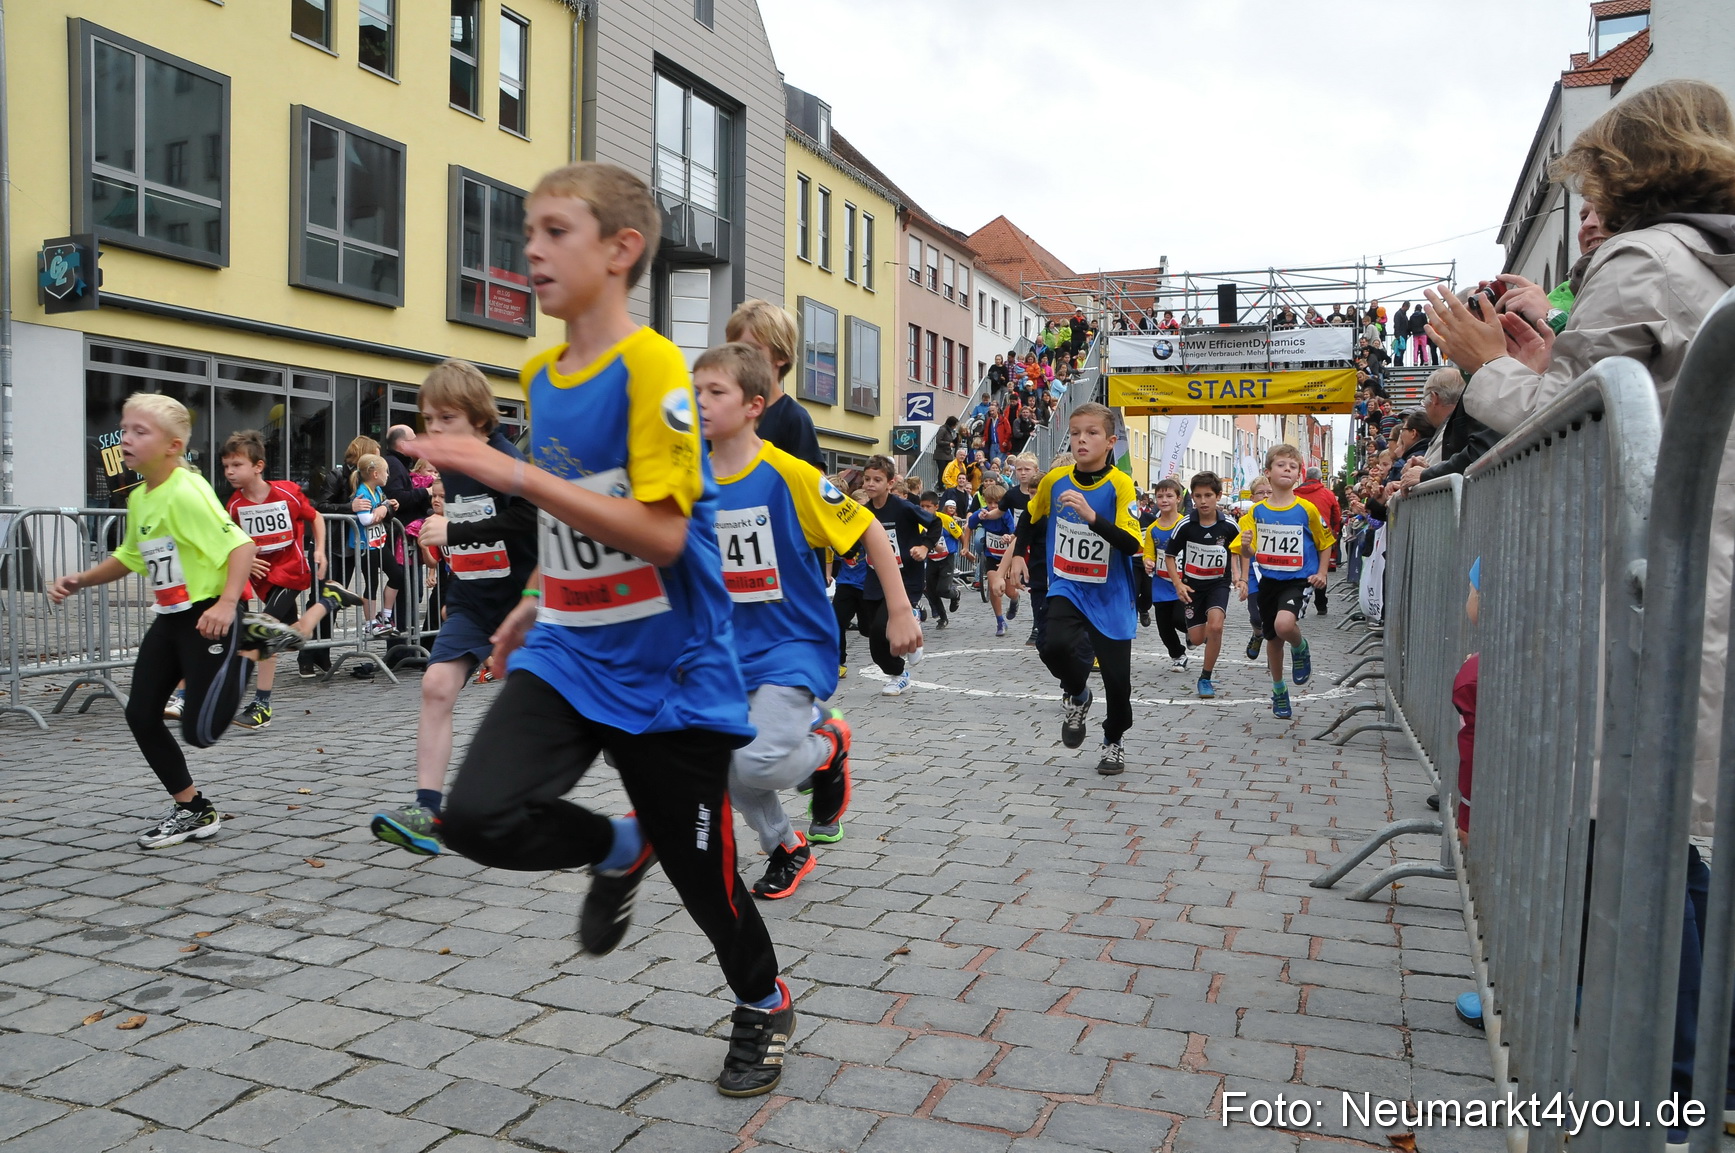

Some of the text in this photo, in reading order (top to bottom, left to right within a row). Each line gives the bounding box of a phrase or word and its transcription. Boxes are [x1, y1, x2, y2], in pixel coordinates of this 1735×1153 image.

[1179, 337, 1306, 353] BMW EfficientDynamics
[1208, 350, 1245, 358] Verbrauch.
[1266, 348, 1306, 356] ahrfreude.
[1187, 378, 1272, 400] START
[1171, 442, 1182, 460] BKK
[244, 512, 287, 534] 7098
[1059, 532, 1105, 562] 7162
[1261, 535, 1299, 553] 7142
[1190, 550, 1224, 568] 7176
[1063, 563, 1089, 575] Lorenz
